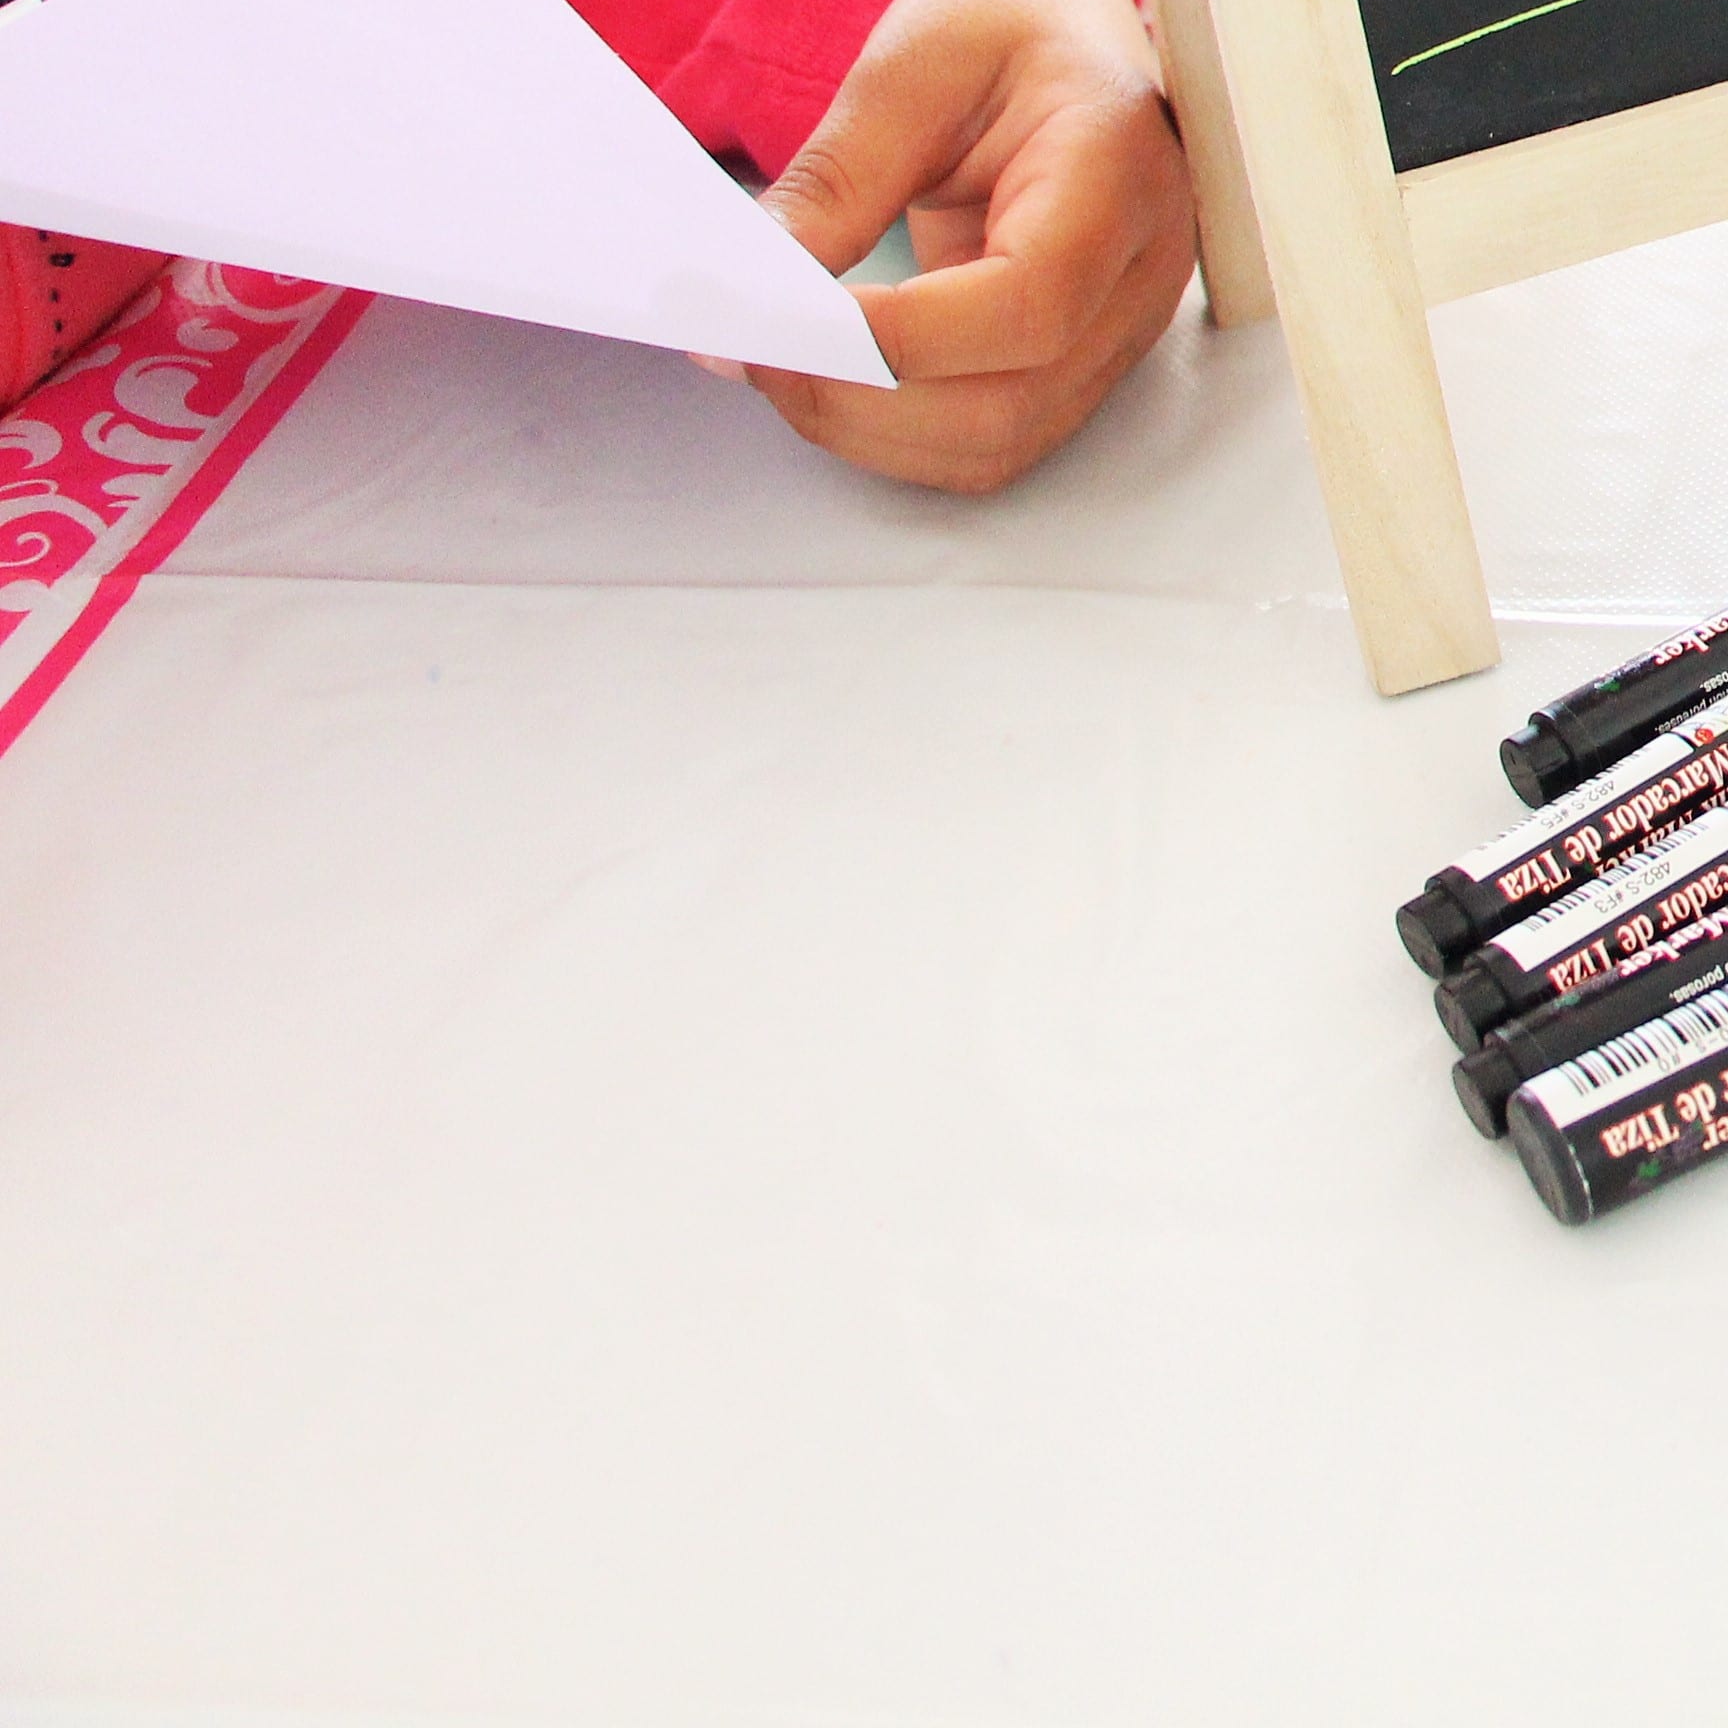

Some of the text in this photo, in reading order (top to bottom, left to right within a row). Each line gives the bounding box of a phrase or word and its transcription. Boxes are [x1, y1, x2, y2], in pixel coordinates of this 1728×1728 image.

[1564, 826, 1601, 863] de
[1497, 850, 1570, 901] Tiza
[1616, 915, 1653, 951] de
[1548, 939, 1618, 994] Tiza
[1676, 1083, 1716, 1124] de
[1602, 1105, 1679, 1156] Tiza
